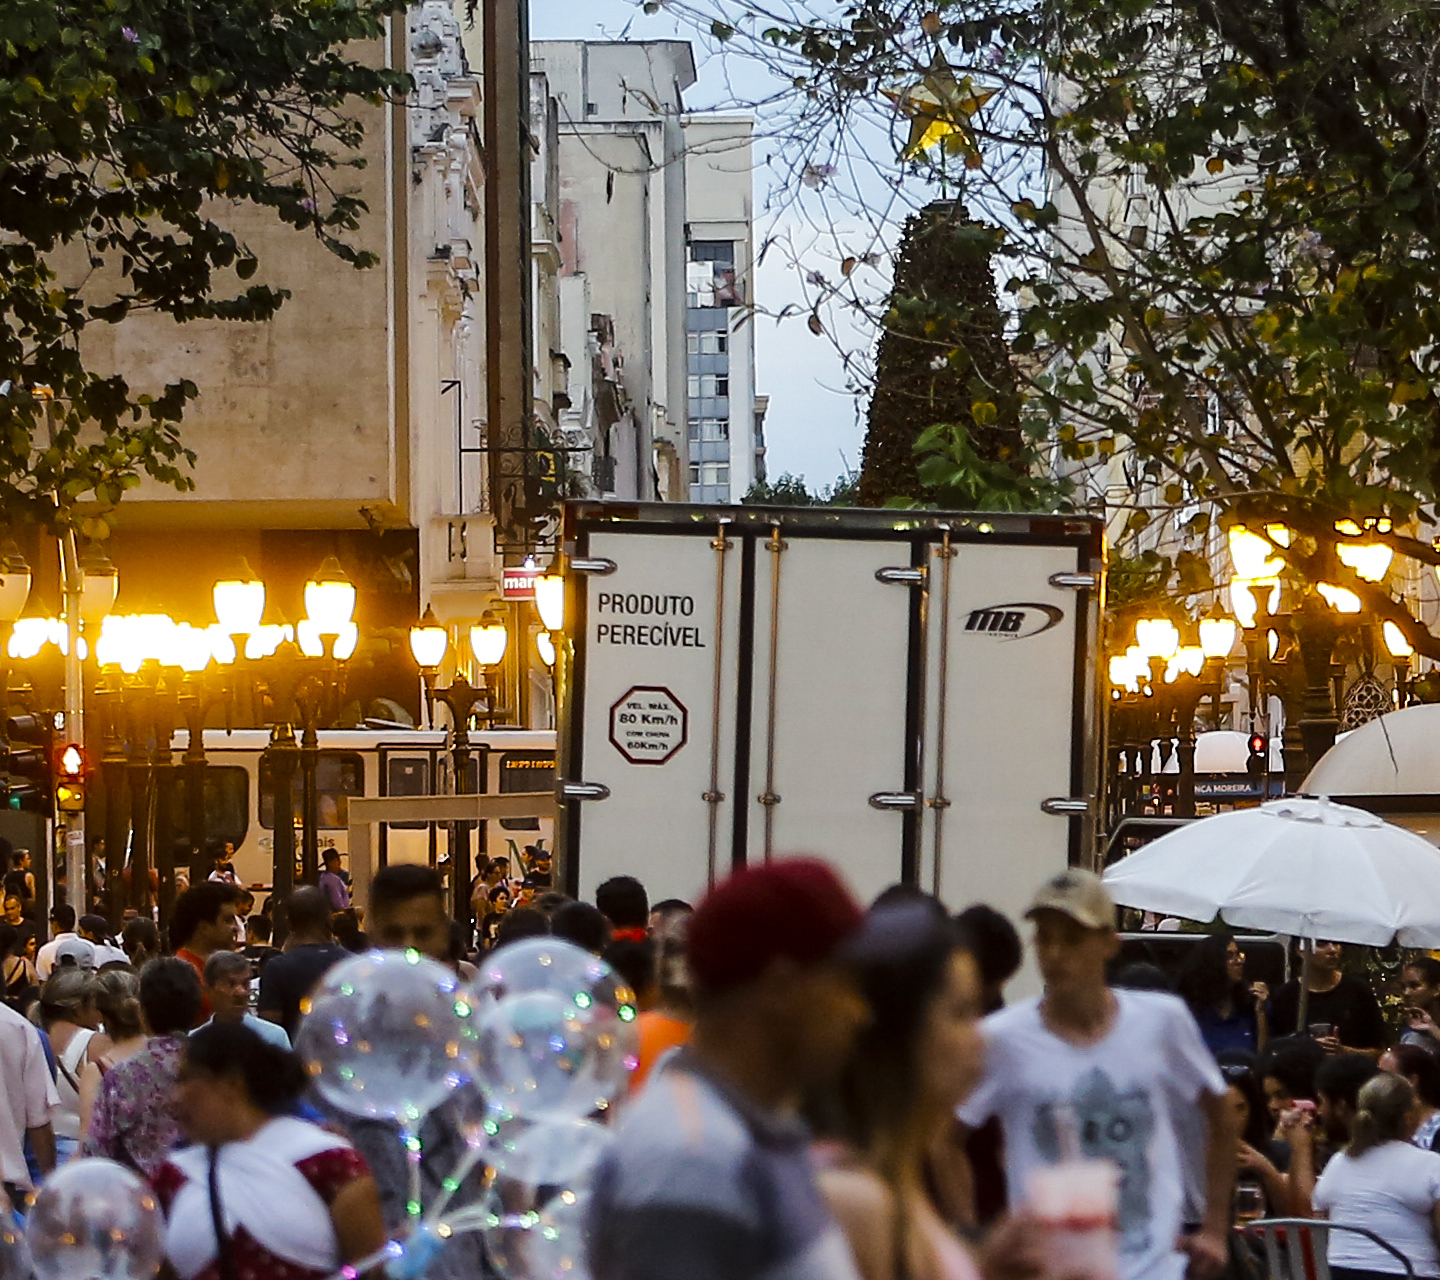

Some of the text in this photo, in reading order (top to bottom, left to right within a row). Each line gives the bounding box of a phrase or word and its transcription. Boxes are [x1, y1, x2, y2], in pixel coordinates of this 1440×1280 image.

[504, 577, 536, 589] mar
[598, 593, 694, 616] PRODUTO
[597, 622, 706, 648] PERECÍVEL
[619, 714, 679, 726] 80 Km/h
[1194, 784, 1252, 793] NCA MOREIRA
